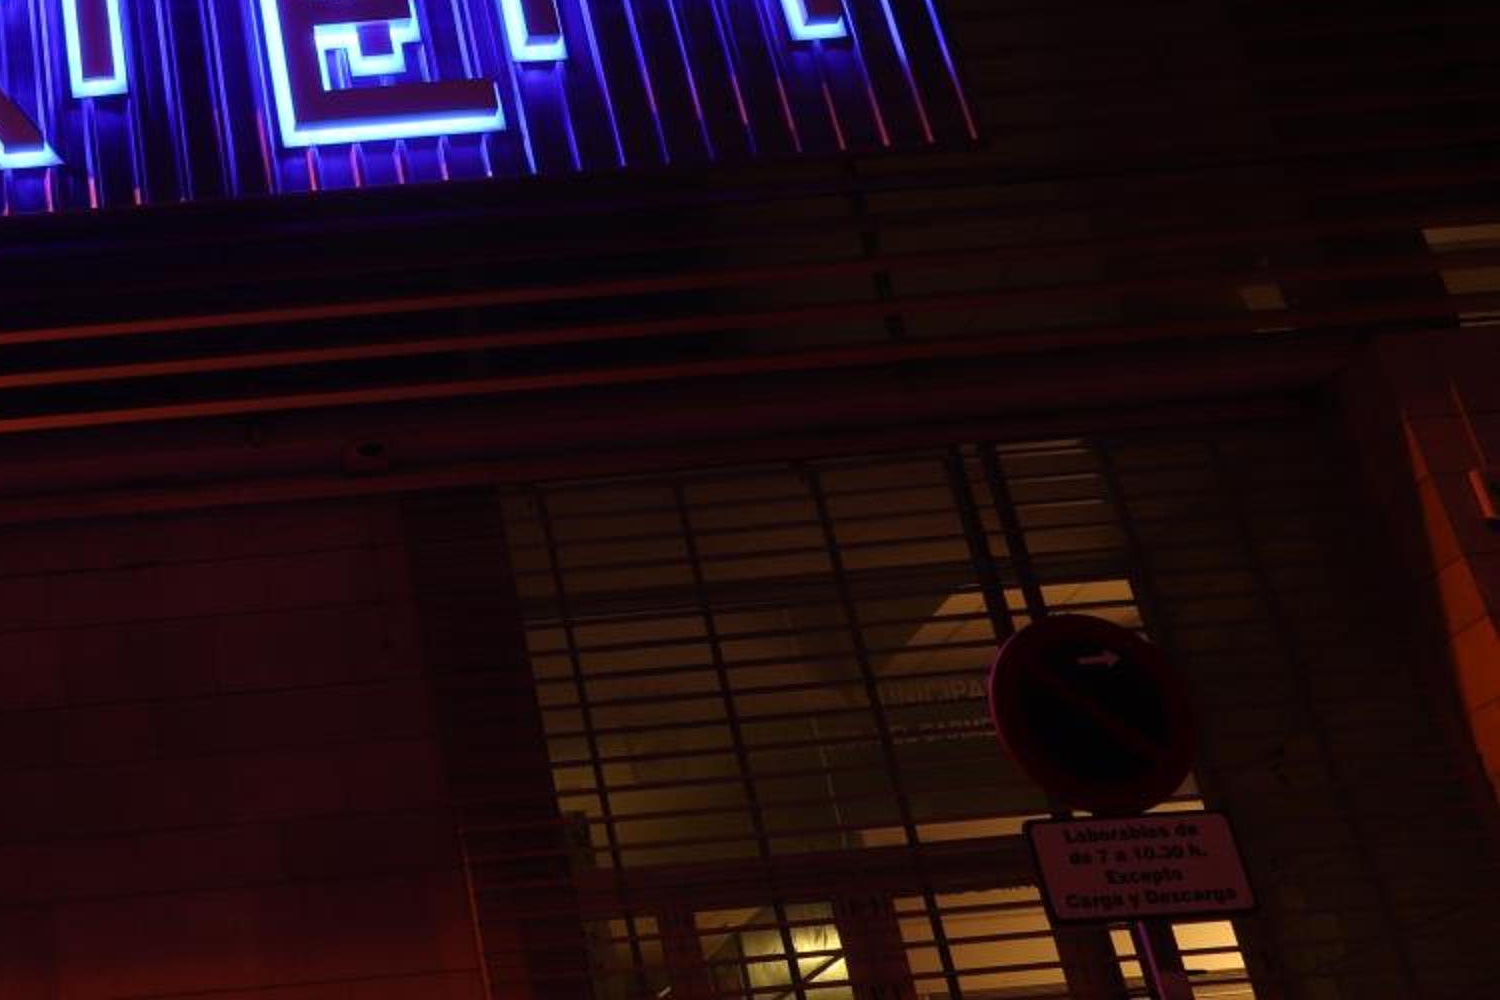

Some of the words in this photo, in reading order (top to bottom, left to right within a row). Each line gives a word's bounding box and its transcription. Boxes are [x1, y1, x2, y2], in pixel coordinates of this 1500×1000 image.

[1063, 823, 1170, 844] Laborables
[1174, 822, 1198, 837] de
[1069, 849, 1092, 865] de
[1105, 867, 1184, 885] Excepto
[1065, 893, 1124, 910] Carga
[1128, 892, 1140, 910] y
[1144, 887, 1238, 905] Descarga
